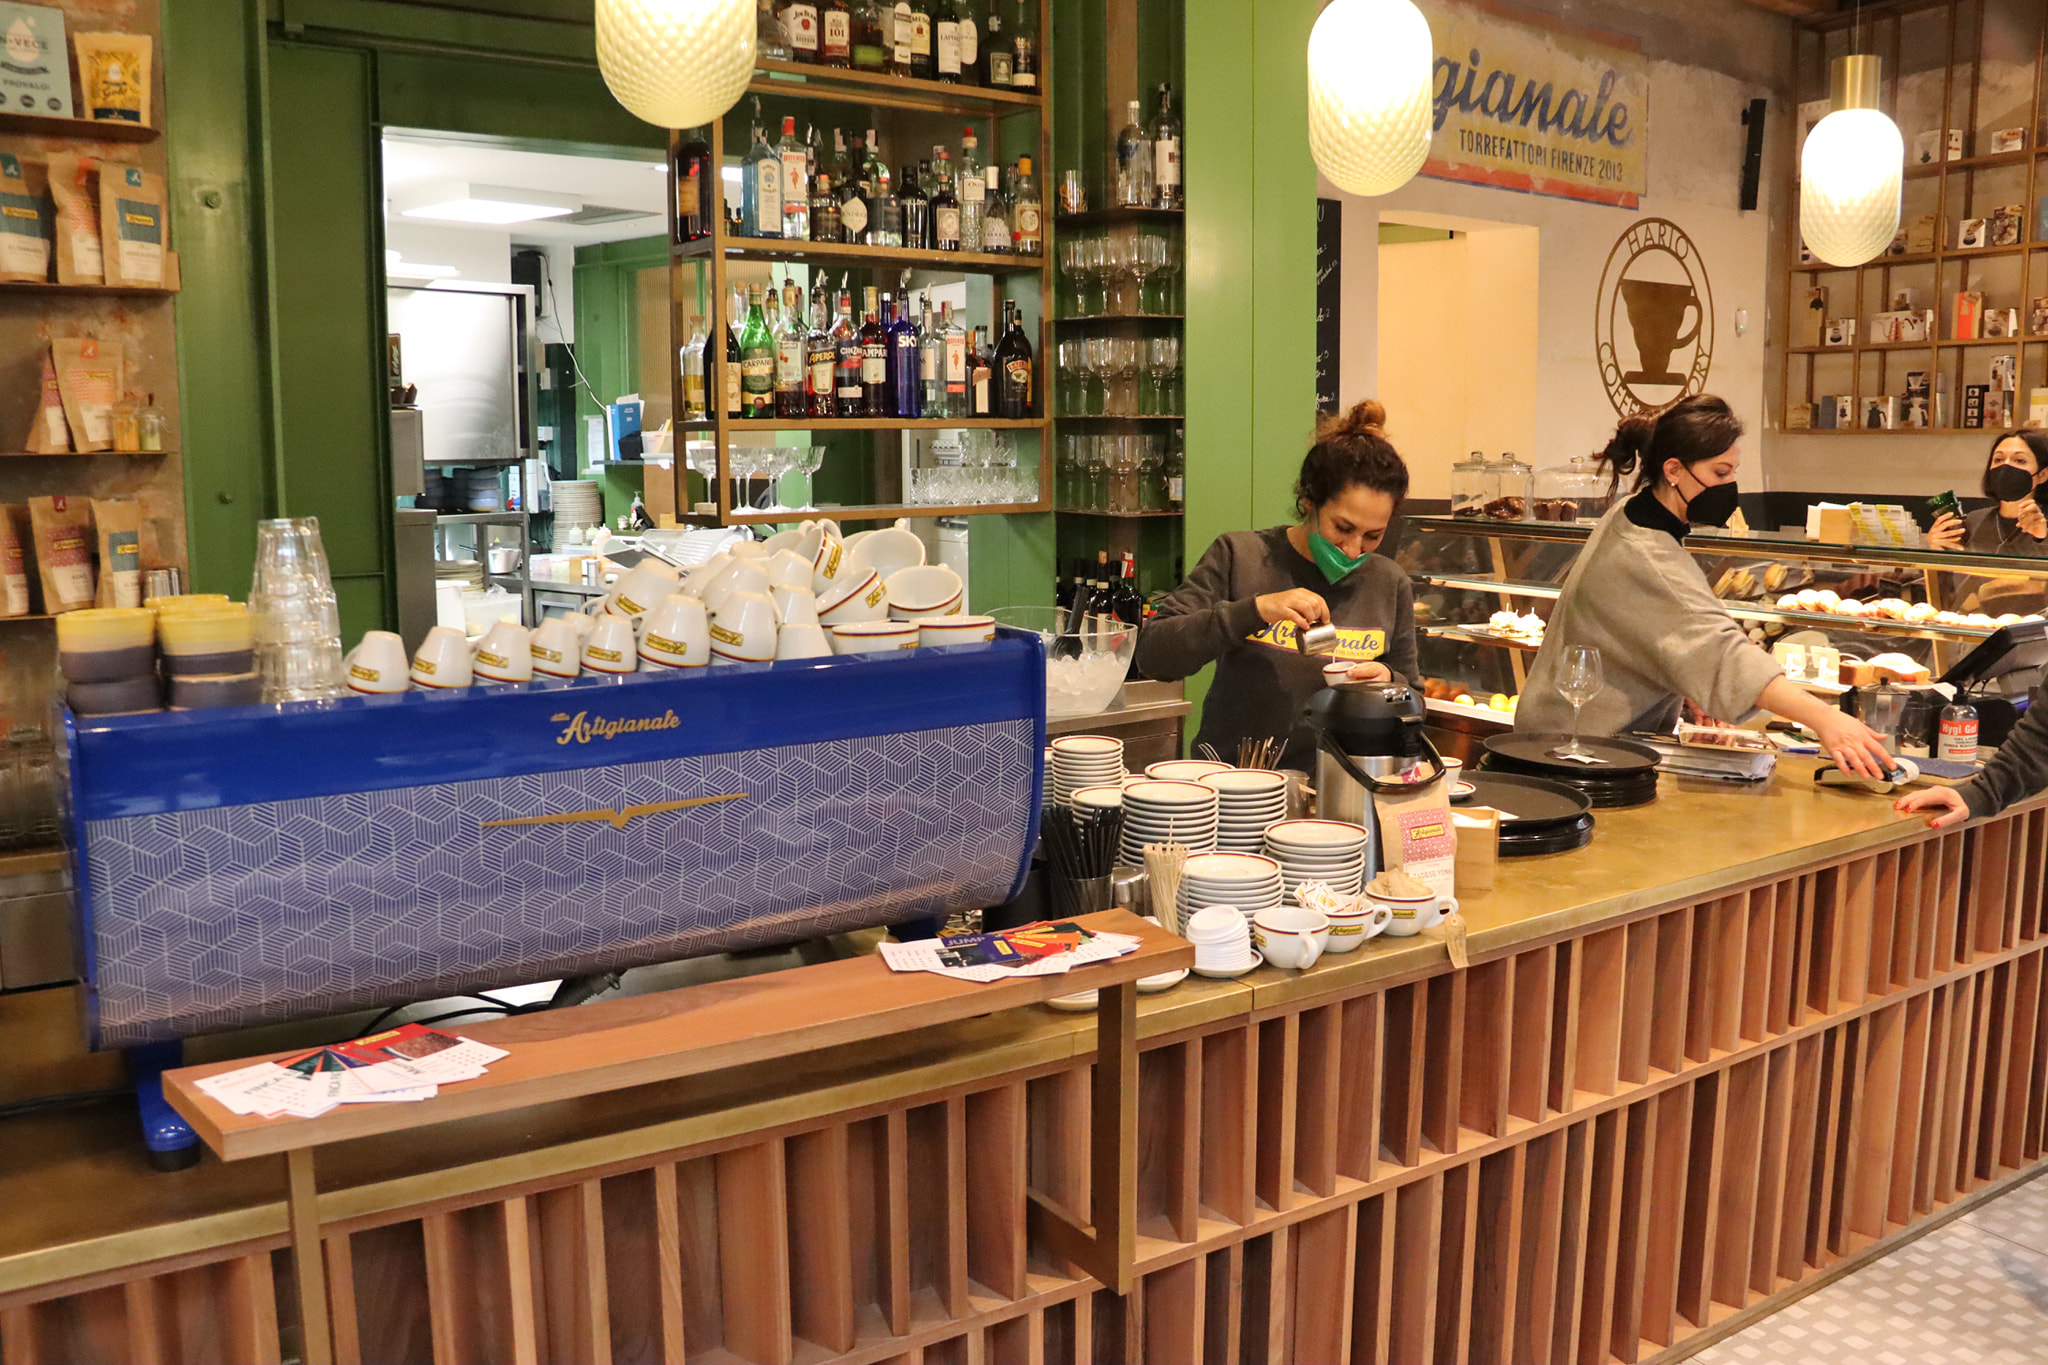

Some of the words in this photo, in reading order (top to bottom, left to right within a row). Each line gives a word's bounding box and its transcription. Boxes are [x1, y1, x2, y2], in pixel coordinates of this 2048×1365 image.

[830, 28, 844, 37] 101
[1433, 49, 1633, 147] gianale
[1459, 128, 1547, 166] TORREFATTORI
[1551, 148, 1596, 177] FIRENZE
[1598, 159, 1624, 182] 2013
[1626, 223, 1690, 261] HARIO
[556, 708, 682, 746] Artigianale
[1942, 723, 1962, 736] Hygi
[1964, 725, 1977, 734] Gel
[946, 935, 986, 946] JUMP
